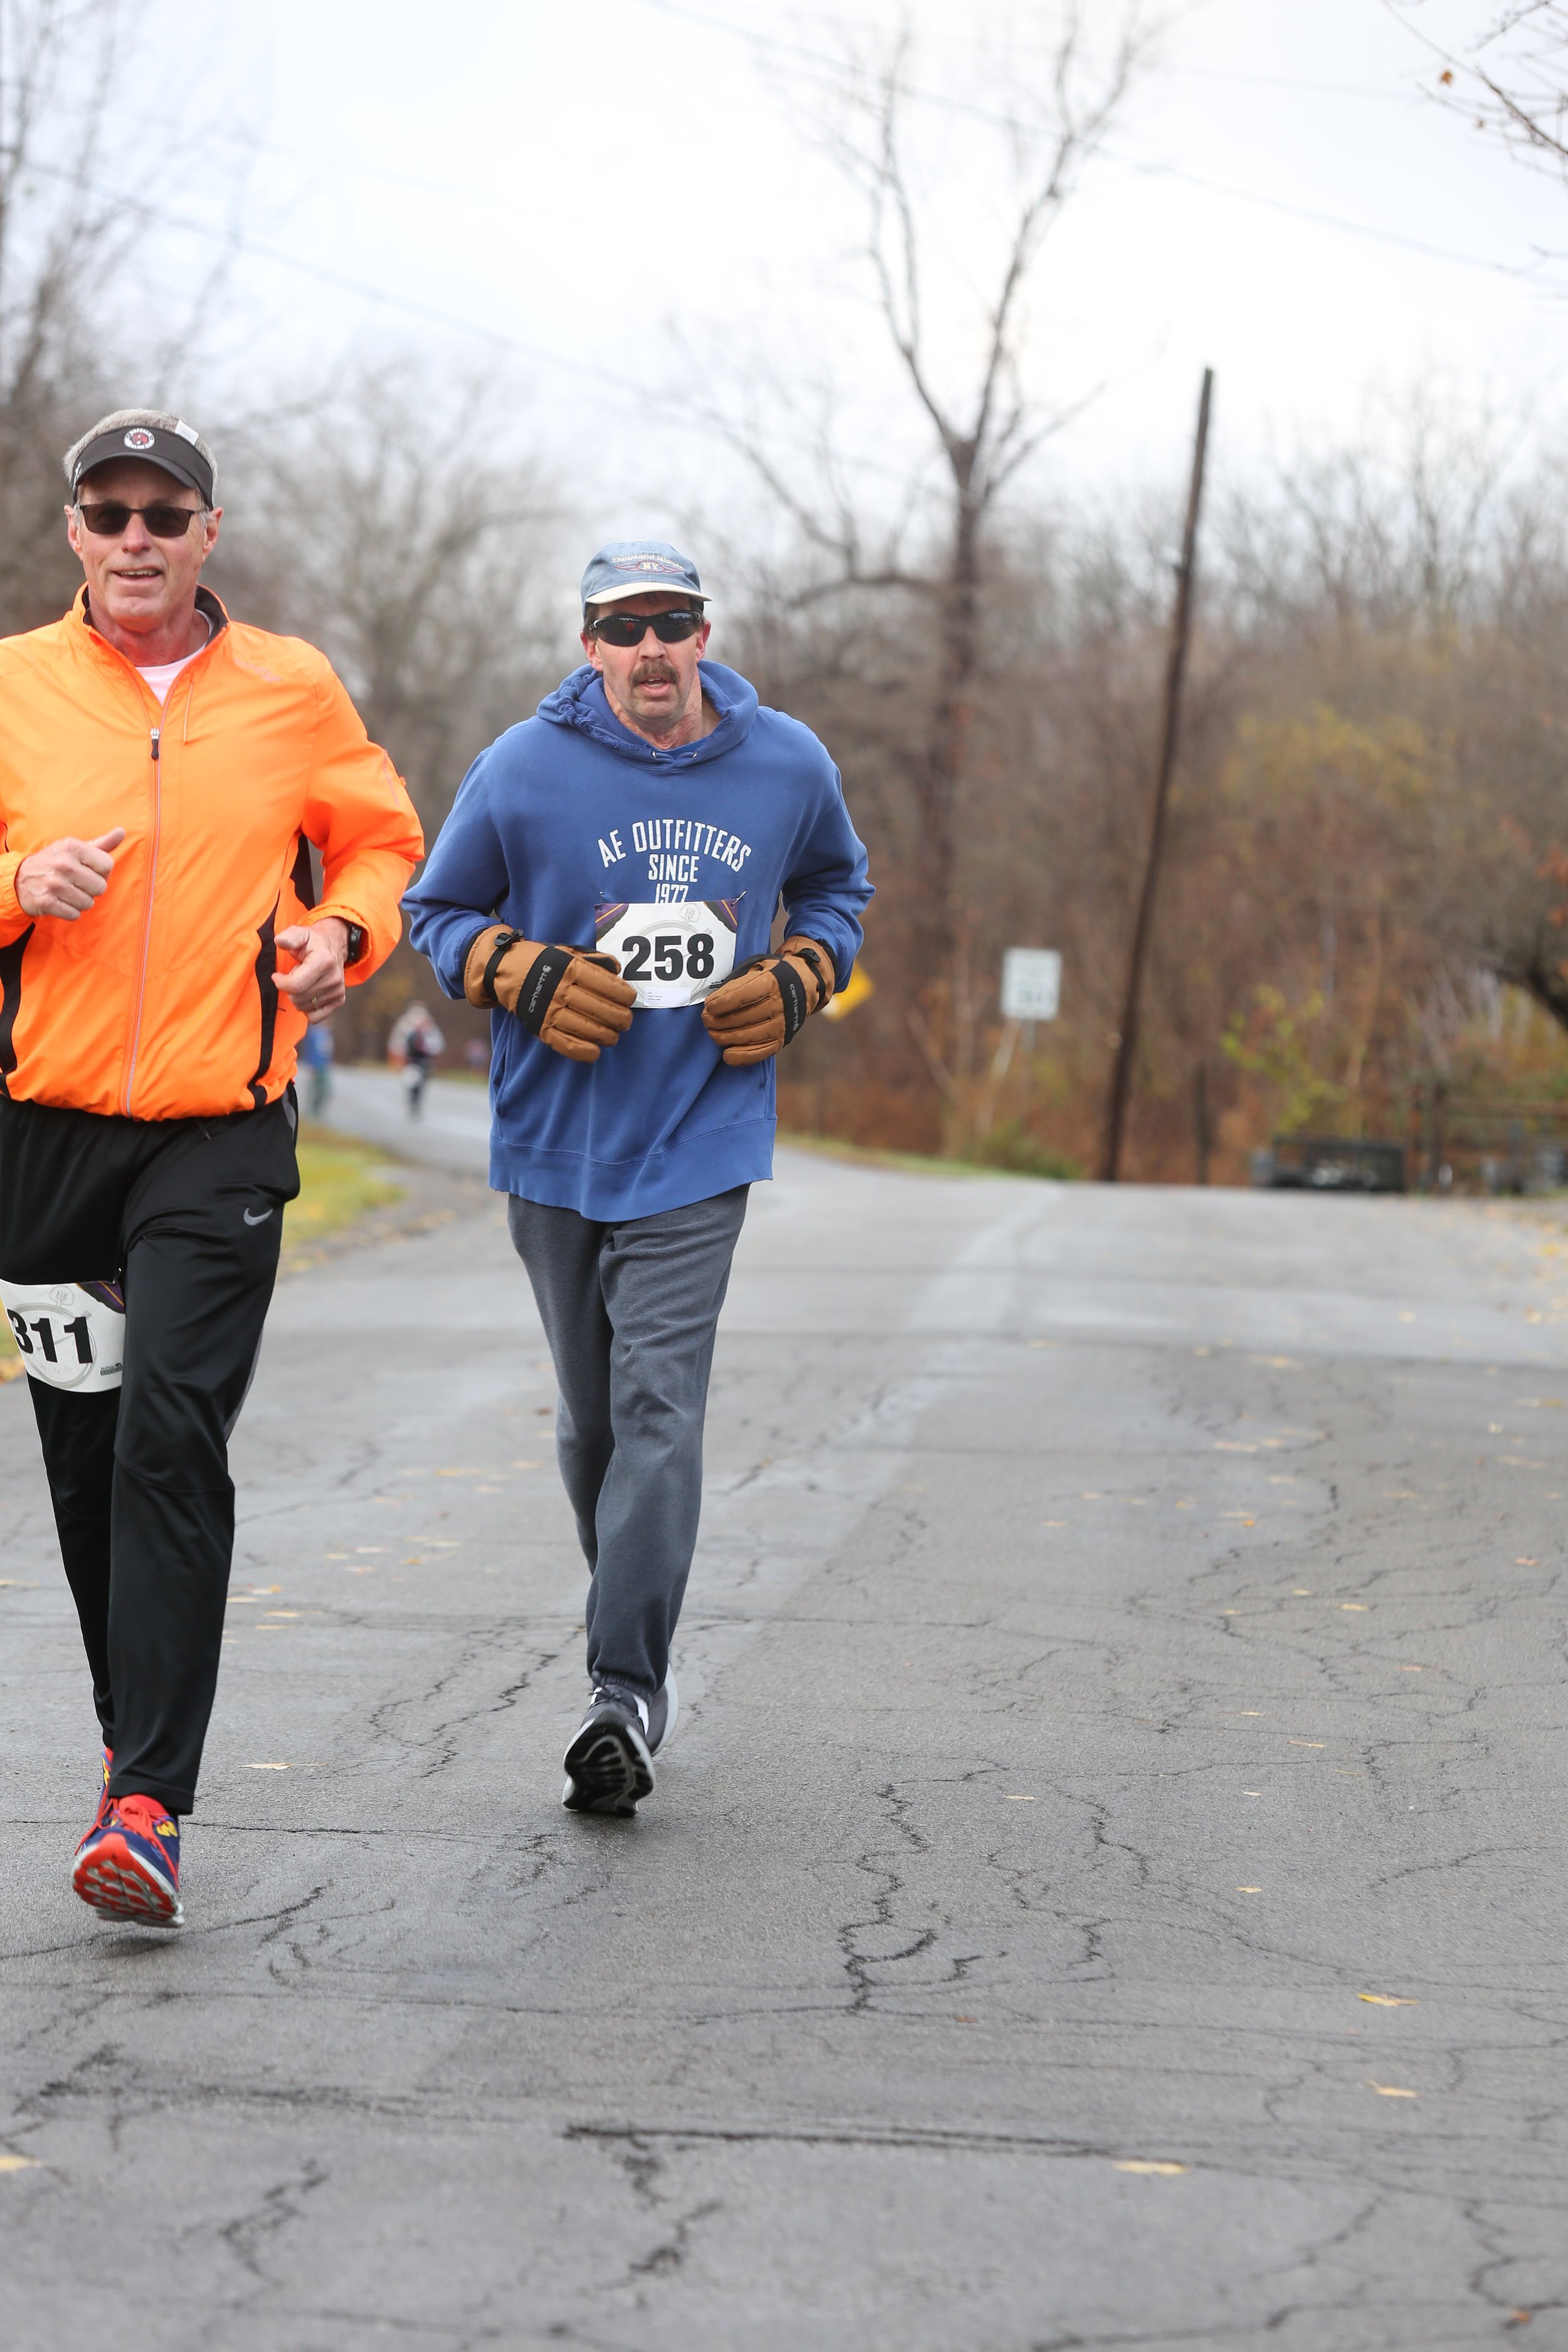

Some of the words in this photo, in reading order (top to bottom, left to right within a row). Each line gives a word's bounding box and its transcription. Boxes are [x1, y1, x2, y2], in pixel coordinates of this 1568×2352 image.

[612, 554, 655, 563] Thousand
[642, 562, 659, 570] NY
[597, 829, 627, 868] AE
[632, 819, 751, 872] OUTFITTERS
[648, 854, 700, 882] SINCE
[655, 883, 689, 903] 1977
[622, 933, 714, 981] 258
[7, 1308, 93, 1364] 311
